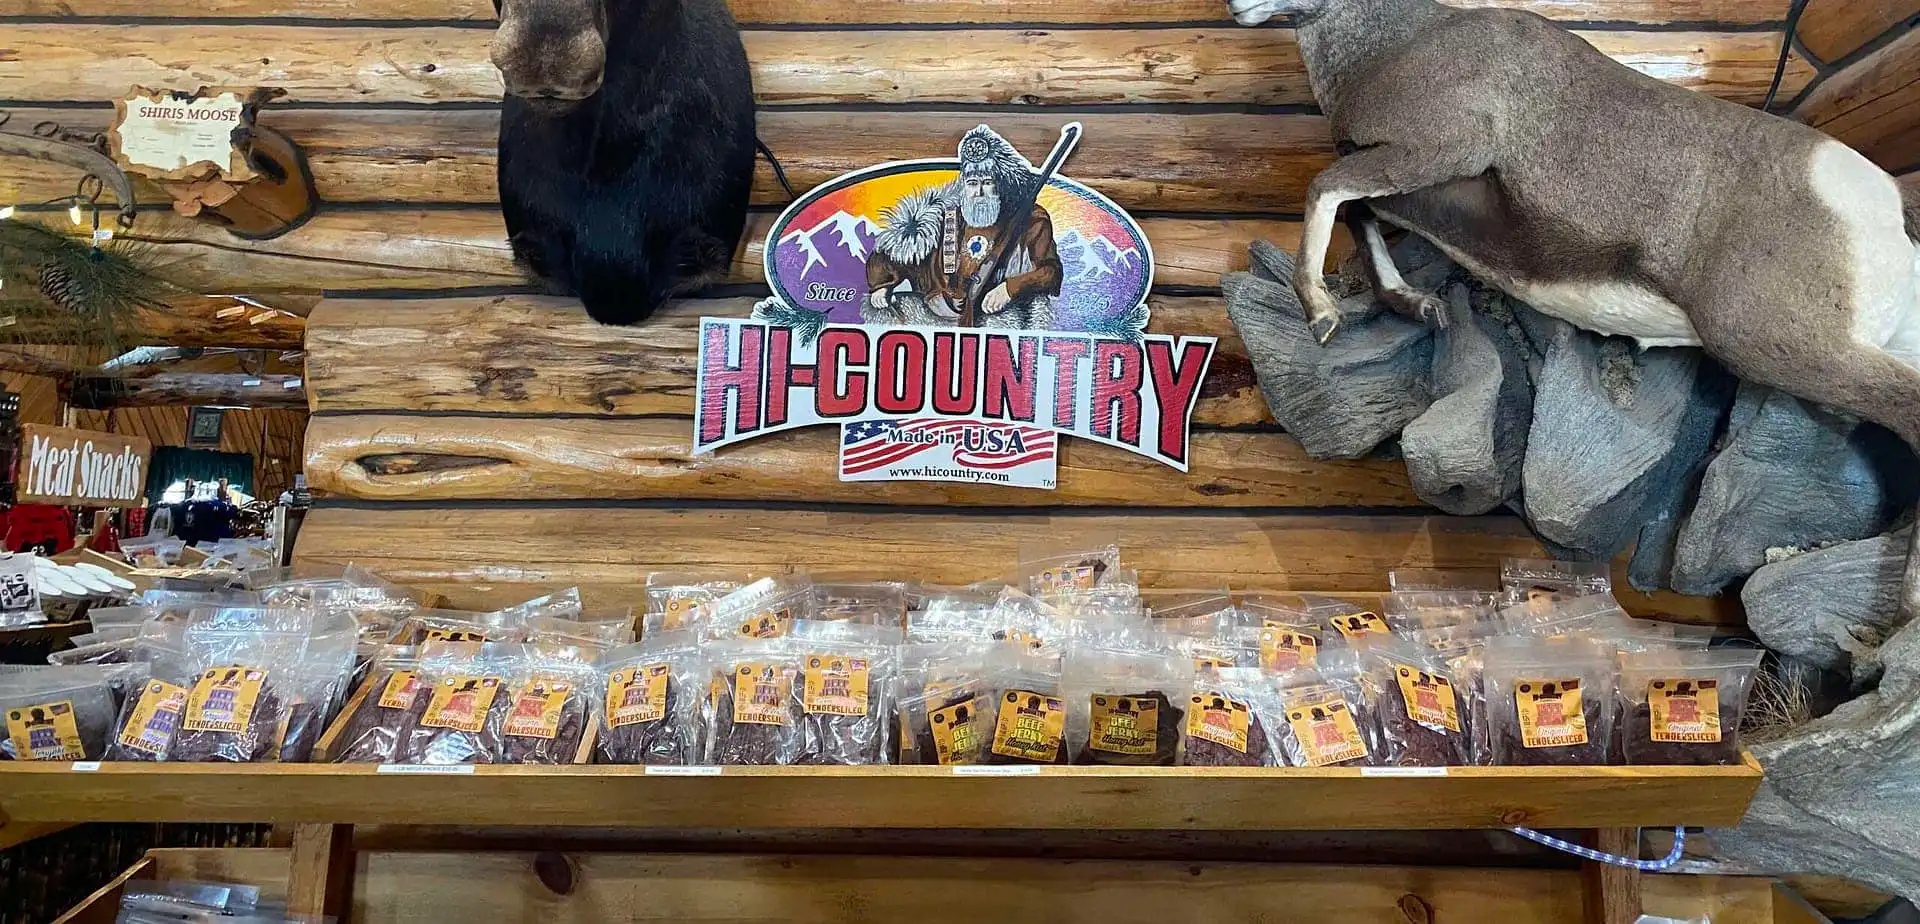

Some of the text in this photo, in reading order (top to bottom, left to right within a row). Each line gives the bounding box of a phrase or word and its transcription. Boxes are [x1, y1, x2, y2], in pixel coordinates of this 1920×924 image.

[140, 106, 238, 121] SHIRIS MOOSE
[806, 282, 856, 301] Since
[699, 323, 1214, 465] HI-COUNTRY
[887, 428, 1027, 454] Made in USA
[26, 434, 141, 500] Meat Snacks
[889, 465, 1010, 482] www.hicountry.com
[1042, 479, 1055, 487] TM
[1016, 717, 1045, 731] BEEF
[1110, 717, 1138, 729] BEEF
[1011, 728, 1045, 742] JERKY
[1105, 726, 1139, 738] JERKY
